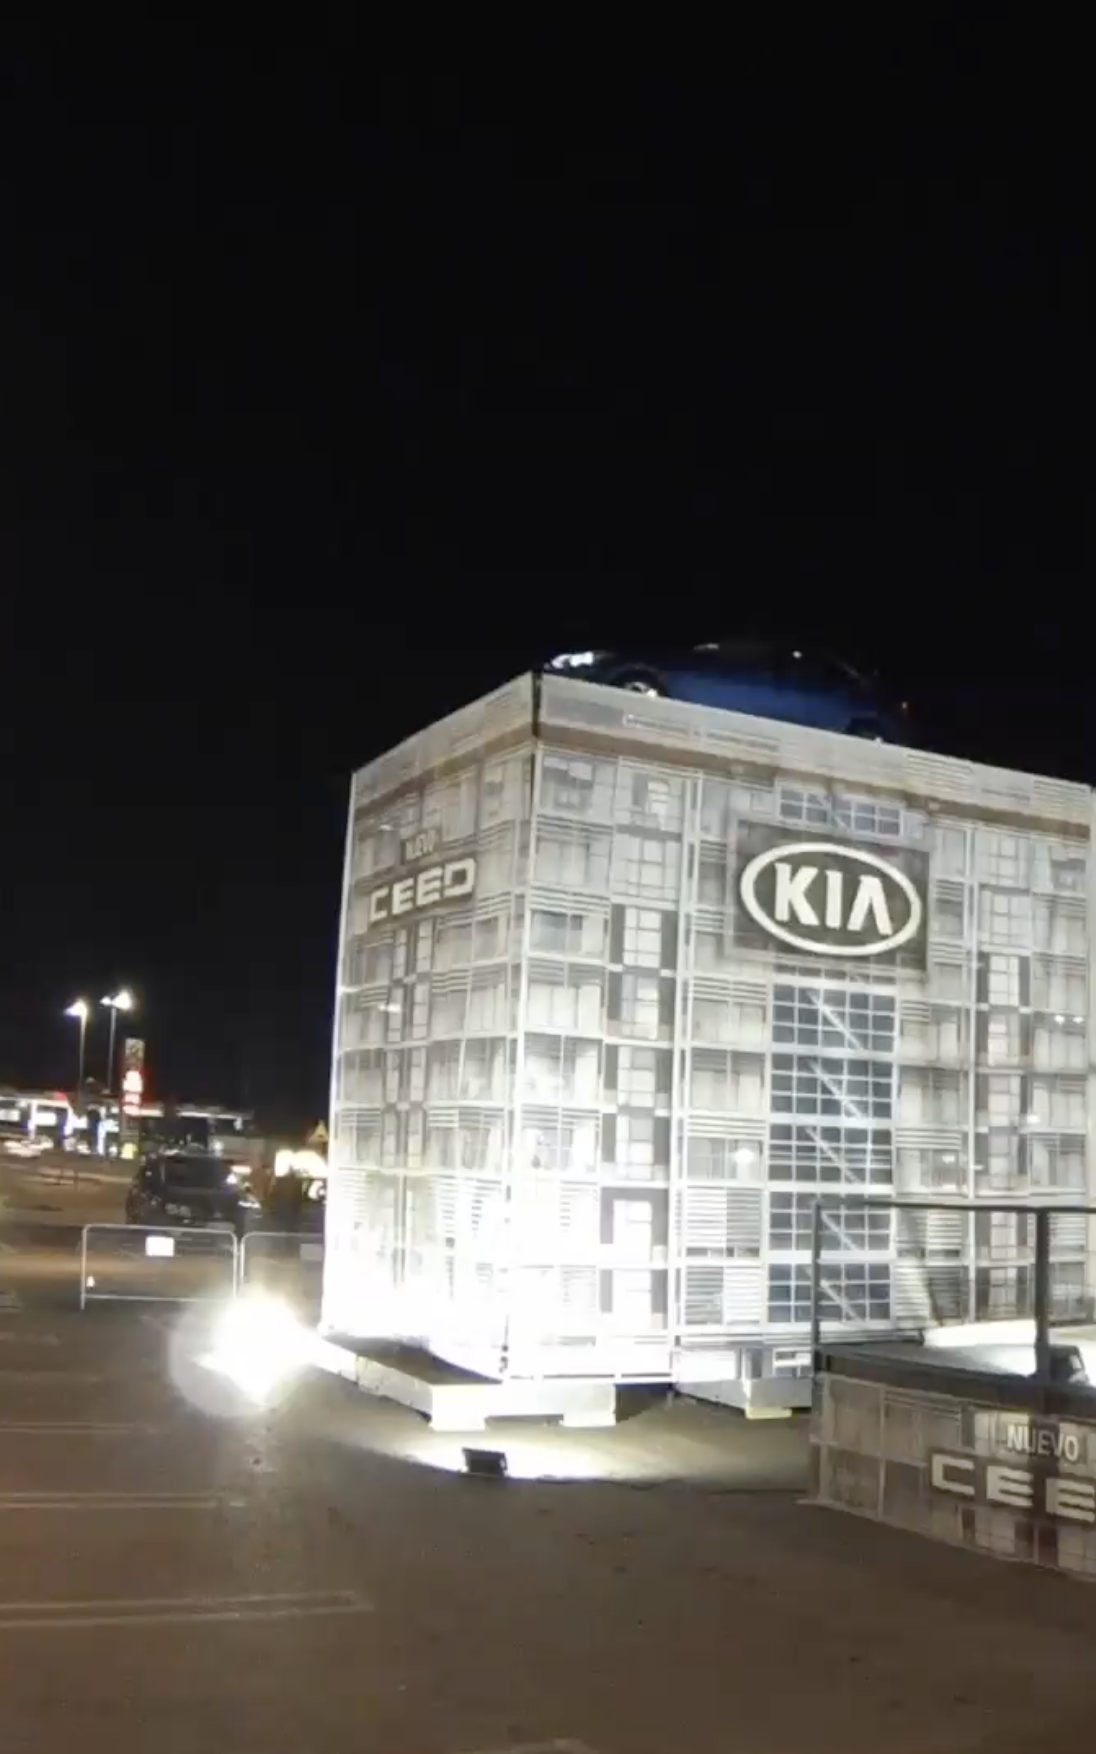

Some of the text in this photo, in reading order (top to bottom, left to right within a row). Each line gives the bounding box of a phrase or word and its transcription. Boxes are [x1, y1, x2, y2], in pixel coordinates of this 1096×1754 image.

[369, 858, 477, 922] CEED
[774, 862, 893, 937] KIA
[1006, 1424, 1080, 1462] NUEVO
